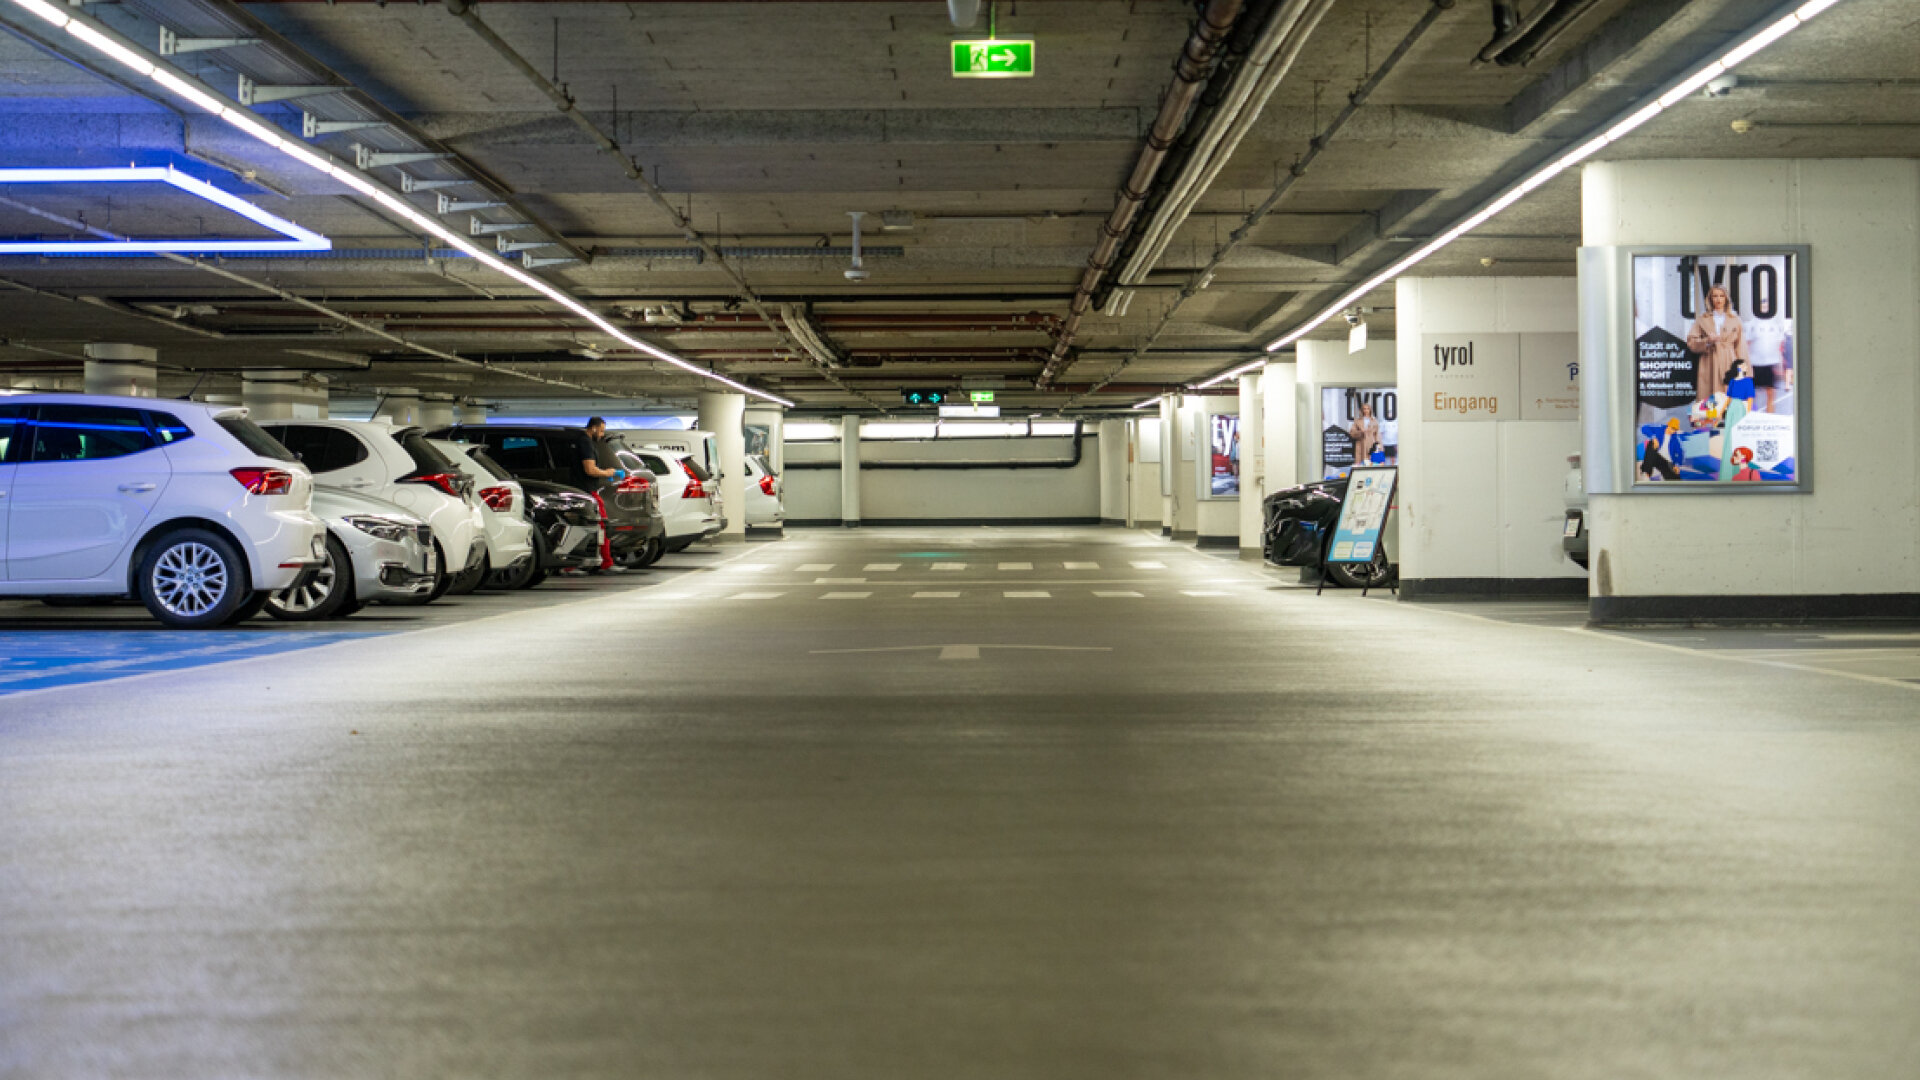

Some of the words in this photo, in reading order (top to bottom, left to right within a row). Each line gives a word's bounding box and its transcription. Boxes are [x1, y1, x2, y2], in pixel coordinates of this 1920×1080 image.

[1677, 255, 1792, 320] tyrol
[1640, 341, 1664, 350] Stadt
[1434, 341, 1473, 371] tyrol
[1640, 350, 1668, 359] Läden
[1669, 350, 1686, 359] auf
[1640, 361, 1692, 370] SHOPPING
[1640, 370, 1672, 380] NIGHT
[1434, 392, 1497, 414] Eingang
